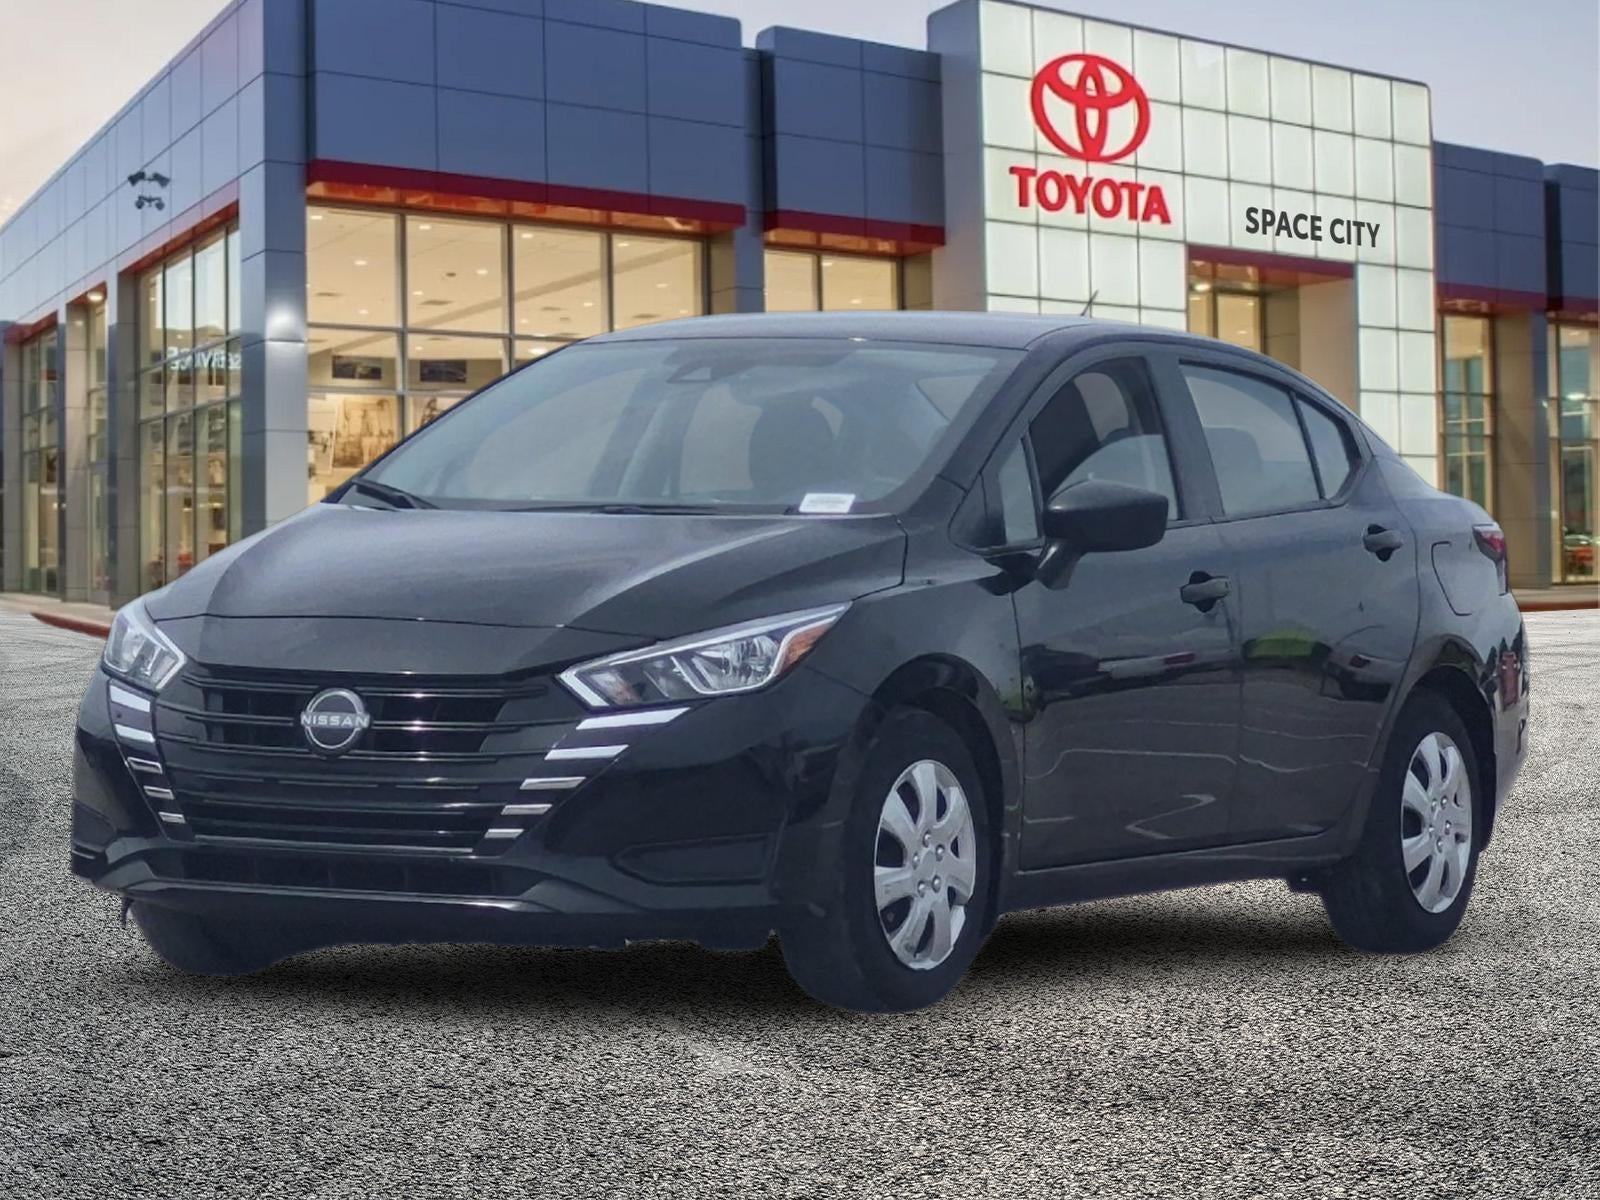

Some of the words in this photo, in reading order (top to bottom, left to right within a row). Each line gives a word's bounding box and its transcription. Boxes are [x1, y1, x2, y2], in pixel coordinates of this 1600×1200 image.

[1010, 166, 1170, 224] TOYOTA
[1245, 206, 1323, 242] SPACE
[1329, 218, 1380, 248] CITY
[300, 713, 370, 728] NISSAN
